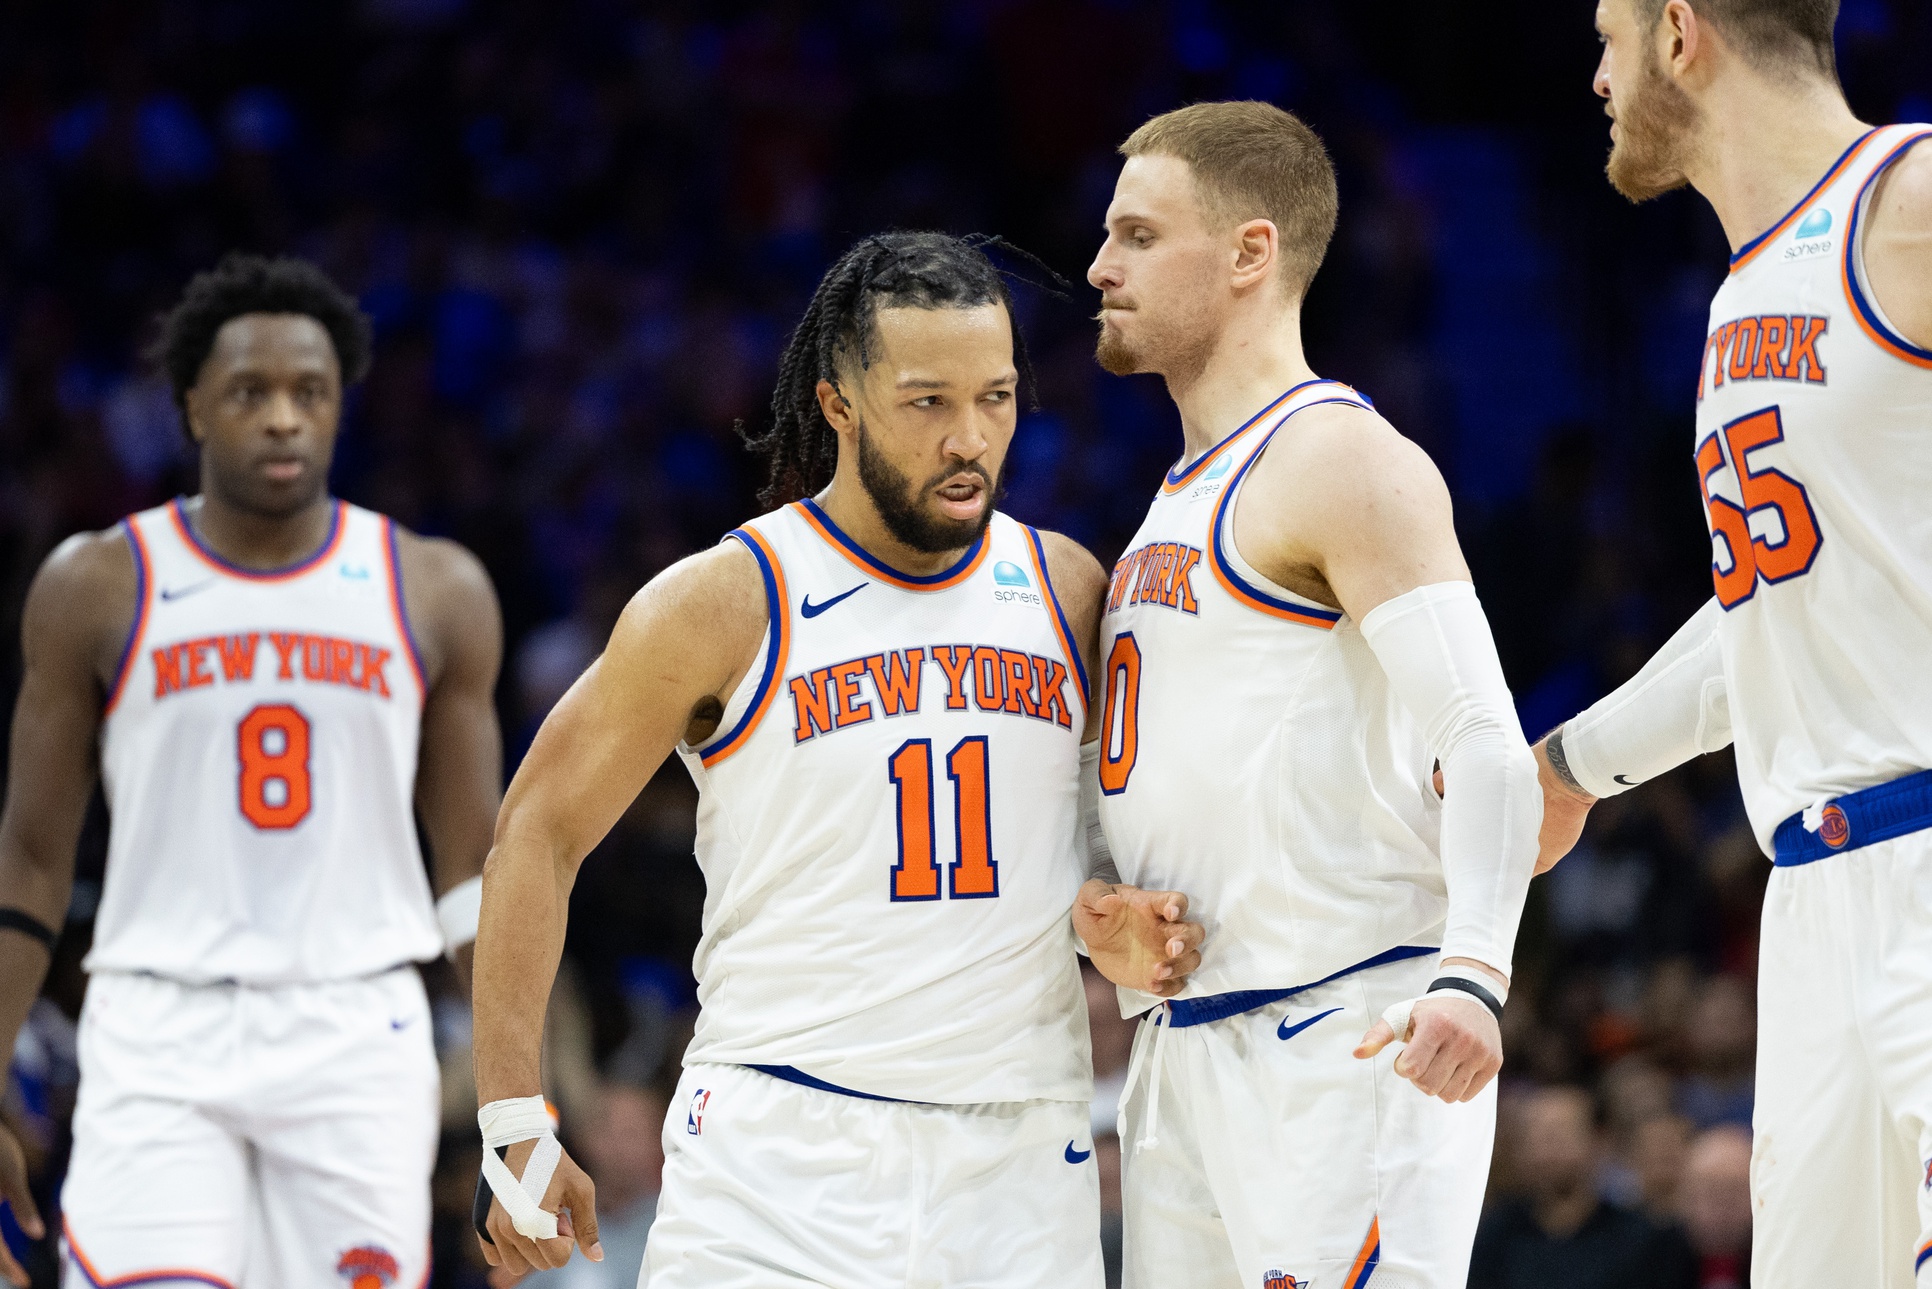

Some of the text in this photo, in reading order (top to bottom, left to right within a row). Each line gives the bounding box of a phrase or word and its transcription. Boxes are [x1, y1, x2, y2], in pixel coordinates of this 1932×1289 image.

[1784, 241, 1832, 259] sphere
[1714, 313, 1830, 391] YORK
[1693, 404, 1824, 613] 55
[994, 589, 1041, 605] sphere
[1129, 541, 1203, 618] YORK
[152, 632, 393, 701] NEW YORK
[787, 643, 1072, 746] NEW YORK
[1098, 630, 1142, 796] 0
[236, 701, 313, 831] 8
[888, 735, 999, 902] 11
